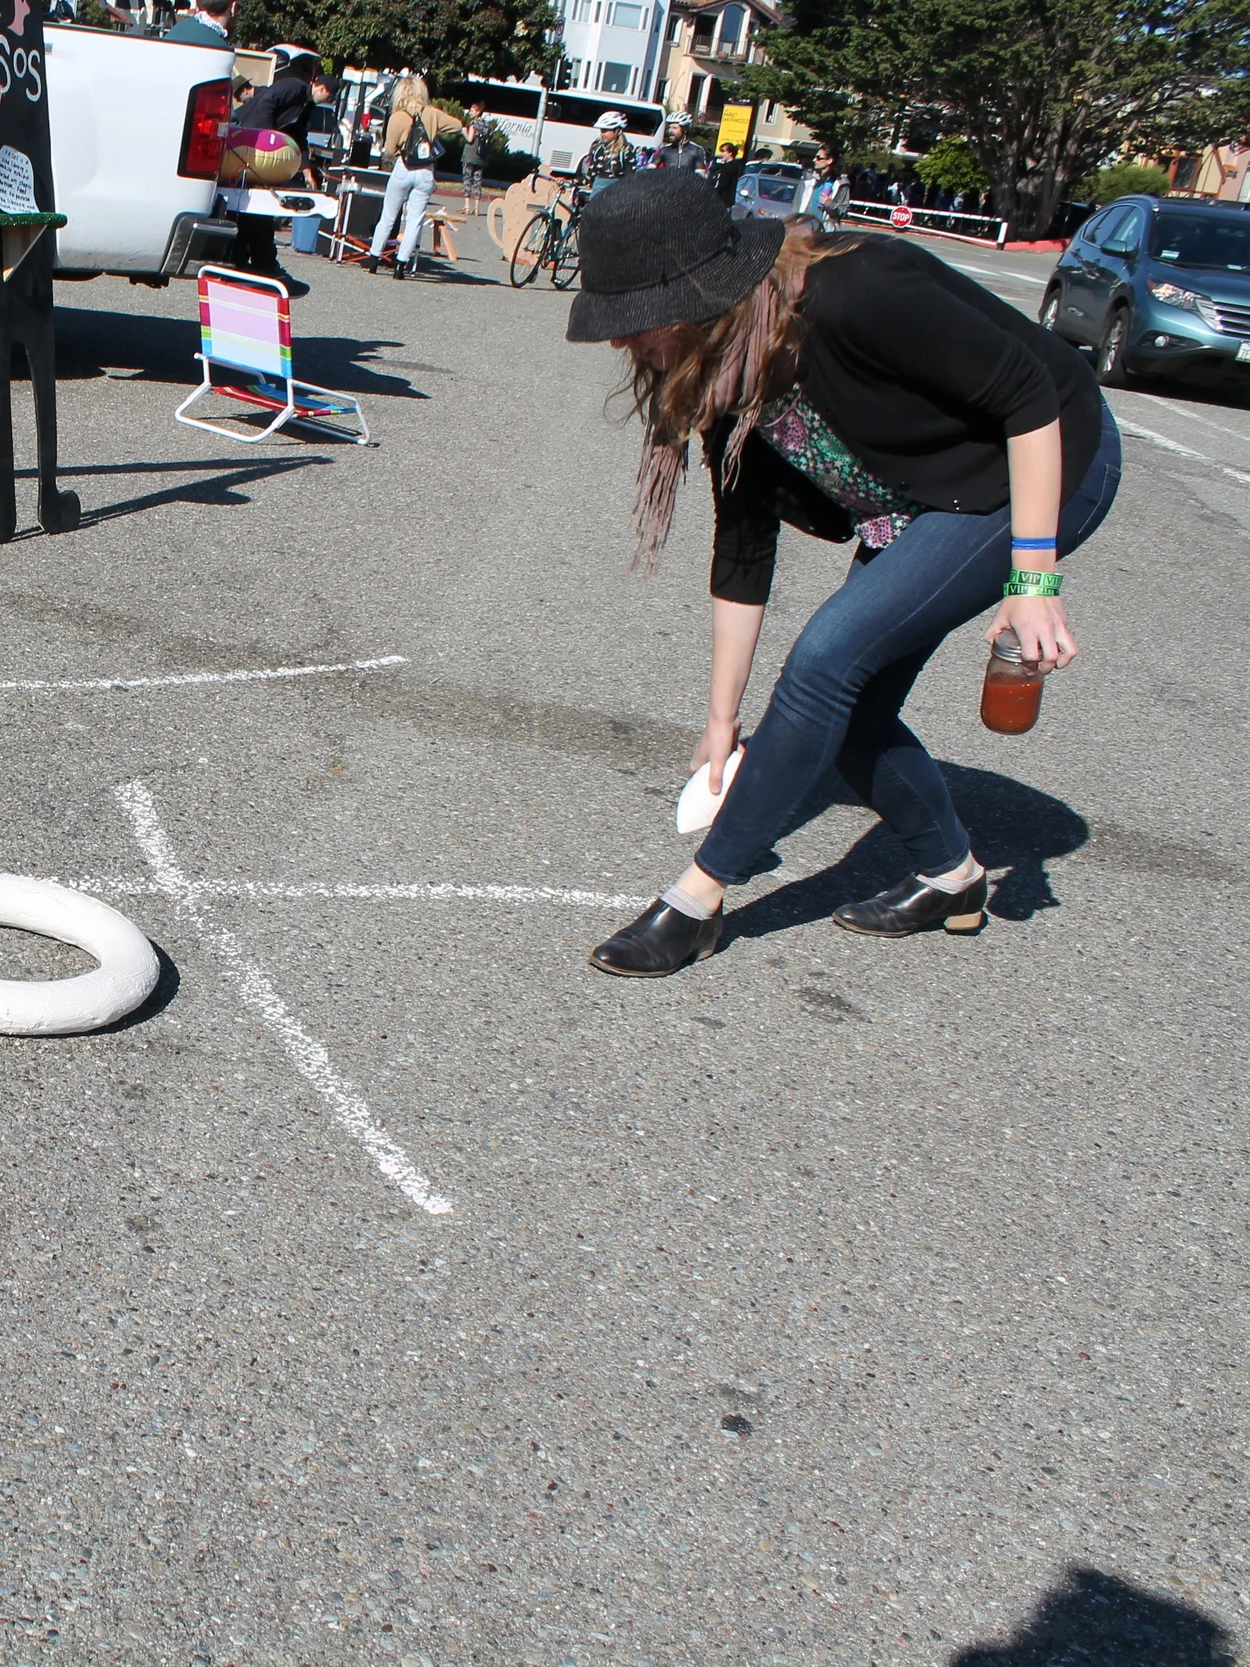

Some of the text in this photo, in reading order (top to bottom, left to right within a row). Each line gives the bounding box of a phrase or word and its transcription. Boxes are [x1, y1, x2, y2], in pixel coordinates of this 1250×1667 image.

[892, 211, 910, 222] STOP
[1020, 572, 1040, 583] VIP
[1010, 585, 1027, 594] VIP
